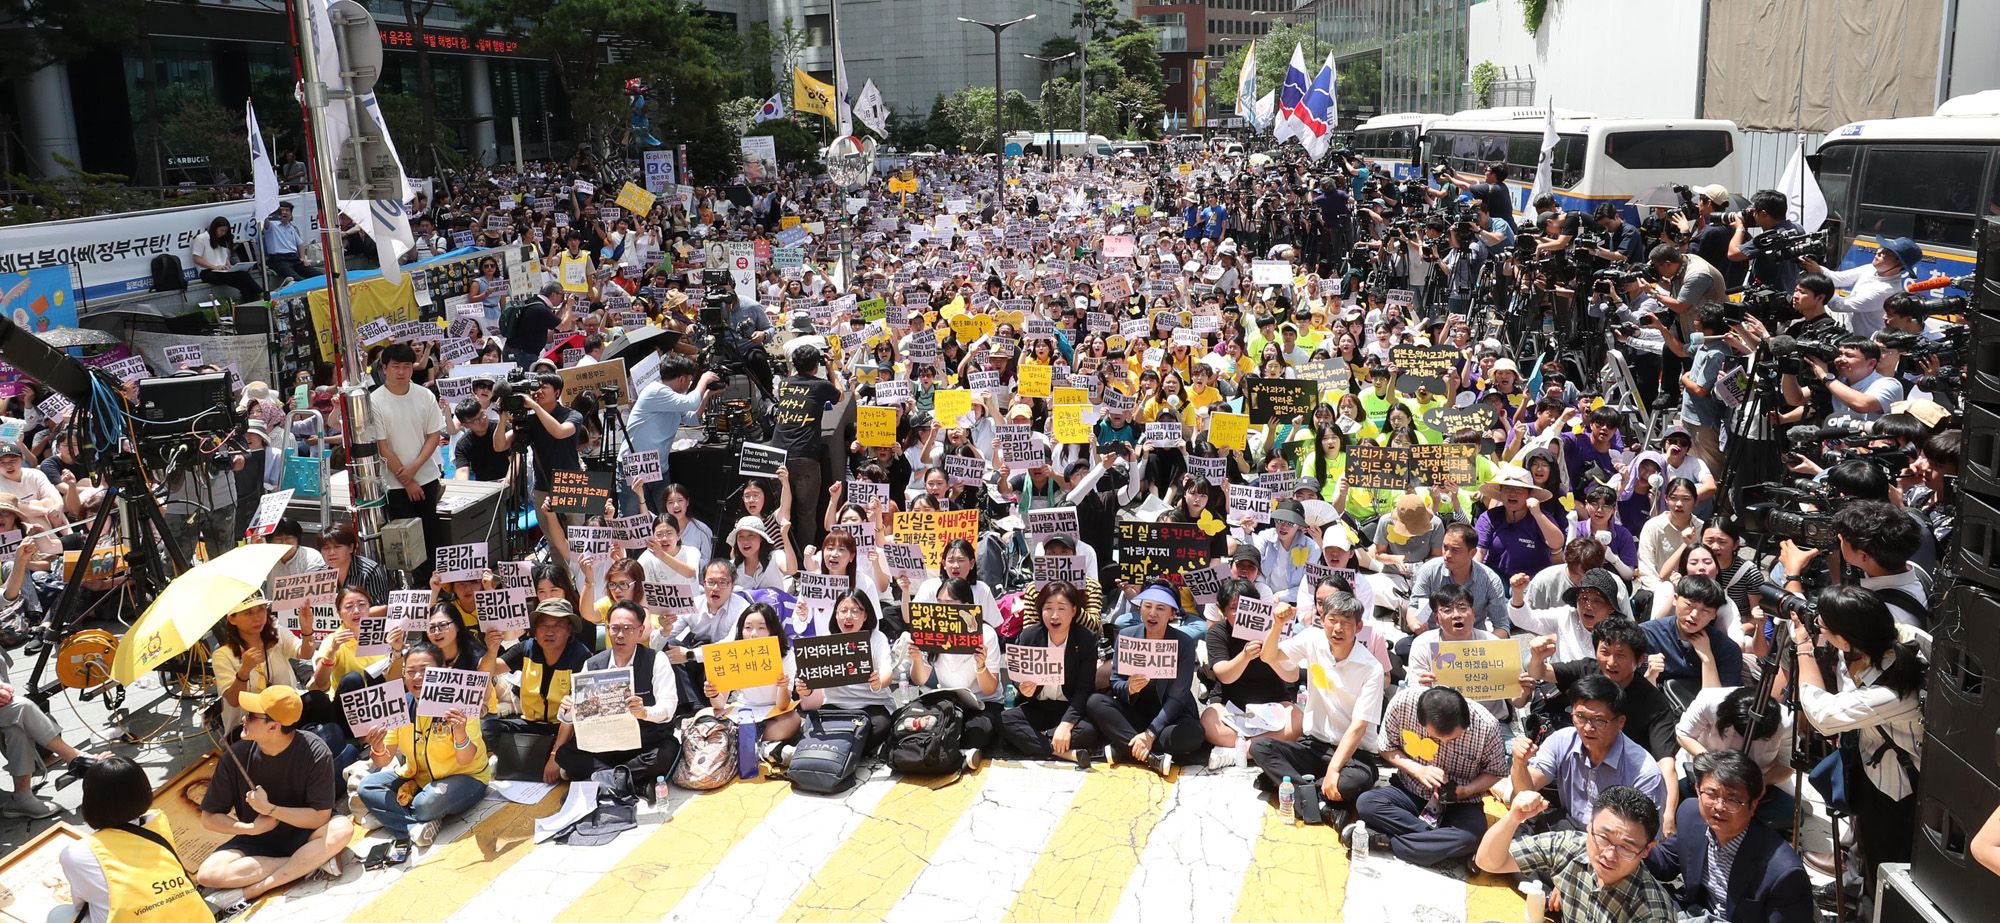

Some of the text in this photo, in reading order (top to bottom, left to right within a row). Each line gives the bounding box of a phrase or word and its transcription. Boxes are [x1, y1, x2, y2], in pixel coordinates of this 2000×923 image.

[389, 30, 413, 46] 음주운
[166, 346, 185, 355] 끝까지
[169, 352, 202, 364] 싸웁시다
[969, 371, 1000, 381] 끝까지 함께
[439, 381, 458, 389] 끝까지
[440, 386, 473, 397] 싸웁시다
[876, 381, 909, 391] 끝까지 함께
[971, 380, 1000, 390] 싸웁시다
[1261, 386, 1286, 394] 사과가
[876, 388, 909, 399] 싸웁시다
[1105, 389, 1121, 400] 끝까지
[1104, 396, 1135, 409] 싸웁시다
[1270, 396, 1294, 405] 어려운
[996, 425, 1030, 433] 끝까지 함께
[1168, 423, 1182, 431] 함께
[996, 433, 1030, 441] 싸웁시다
[1147, 431, 1181, 441] 싸웁시다
[1003, 441, 1033, 452] 우리가
[1411, 446, 1461, 459] 일본정부는
[623, 452, 659, 466] 끝까지 함께
[946, 455, 985, 468] 끝까지 함께
[1003, 451, 1044, 463] 증인이다
[1188, 456, 1227, 467] 끝까지 함께
[1350, 448, 1409, 464] 저희가 계속
[622, 462, 660, 478] 싸웁시다
[1360, 461, 1393, 474] 위드유
[1417, 458, 1470, 471] 전쟁범죄를
[945, 466, 985, 480] 싸웁시다
[1188, 469, 1226, 478] 싸웁시다
[1261, 471, 1296, 483] 끝까지 함께
[1431, 473, 1472, 485] 인정해라
[849, 483, 878, 493] 우리가
[1261, 481, 1297, 492] 싸웁시다
[1348, 474, 1408, 489] 하겠습니다
[1230, 486, 1272, 499] 끝까지 함께
[1230, 498, 1271, 514] 싸웁시다
[606, 514, 652, 529] 끝까지 함께
[898, 511, 977, 530] 진실은 아베정부
[1029, 513, 1077, 523] 끝까지 함께
[568, 528, 612, 539] 끝까지 함께
[612, 526, 652, 541] 싸웁시다
[1031, 521, 1078, 533] 싸웁시다
[437, 546, 474, 561] 우리가
[569, 541, 611, 554] 싸웁시다
[883, 544, 911, 557] 우리가
[1123, 546, 1170, 557] 가려지지
[436, 557, 488, 574] 증인이다
[886, 556, 924, 570] 증인이다
[1034, 558, 1073, 569] 우리가
[1034, 567, 1086, 582] 증인이다
[1120, 563, 1148, 584] 진실
[1183, 569, 1218, 584] 우리가
[1305, 564, 1355, 580] 끝까지 함께
[275, 570, 338, 589] 끝까지 함께
[801, 573, 849, 588] 끝까지 함께
[273, 581, 336, 602] 싸웁시다
[643, 583, 679, 596] 우리가
[1188, 580, 1231, 596] 증인이
[389, 592, 430, 605] 끝까지 함께
[475, 591, 510, 607] 우리가
[647, 594, 694, 608] 증인이다
[294, 607, 334, 618] GOMIA
[387, 605, 430, 620] 싸웁시다
[477, 603, 527, 621] 증인이다
[1239, 598, 1273, 616] 끝까지
[360, 619, 386, 632] 우리
[1120, 638, 1177, 653] 끝까지 함께
[1462, 647, 1486, 656] 당신을
[1007, 647, 1048, 662] 우리가
[1119, 651, 1176, 668] 싸웁시다
[1008, 659, 1063, 675] 증인이다
[1447, 659, 1504, 669] 기억 하겠습니다
[425, 670, 488, 688] 끝까지 함께
[1465, 673, 1488, 682] 당신과
[422, 685, 484, 706] 싸웁시다
[1466, 684, 1505, 694] 하겠습니다
[343, 687, 386, 710] 우리가
[348, 697, 406, 726] 증인이다
[152, 876, 185, 895] Stop
[134, 891, 185, 916] Violence against
